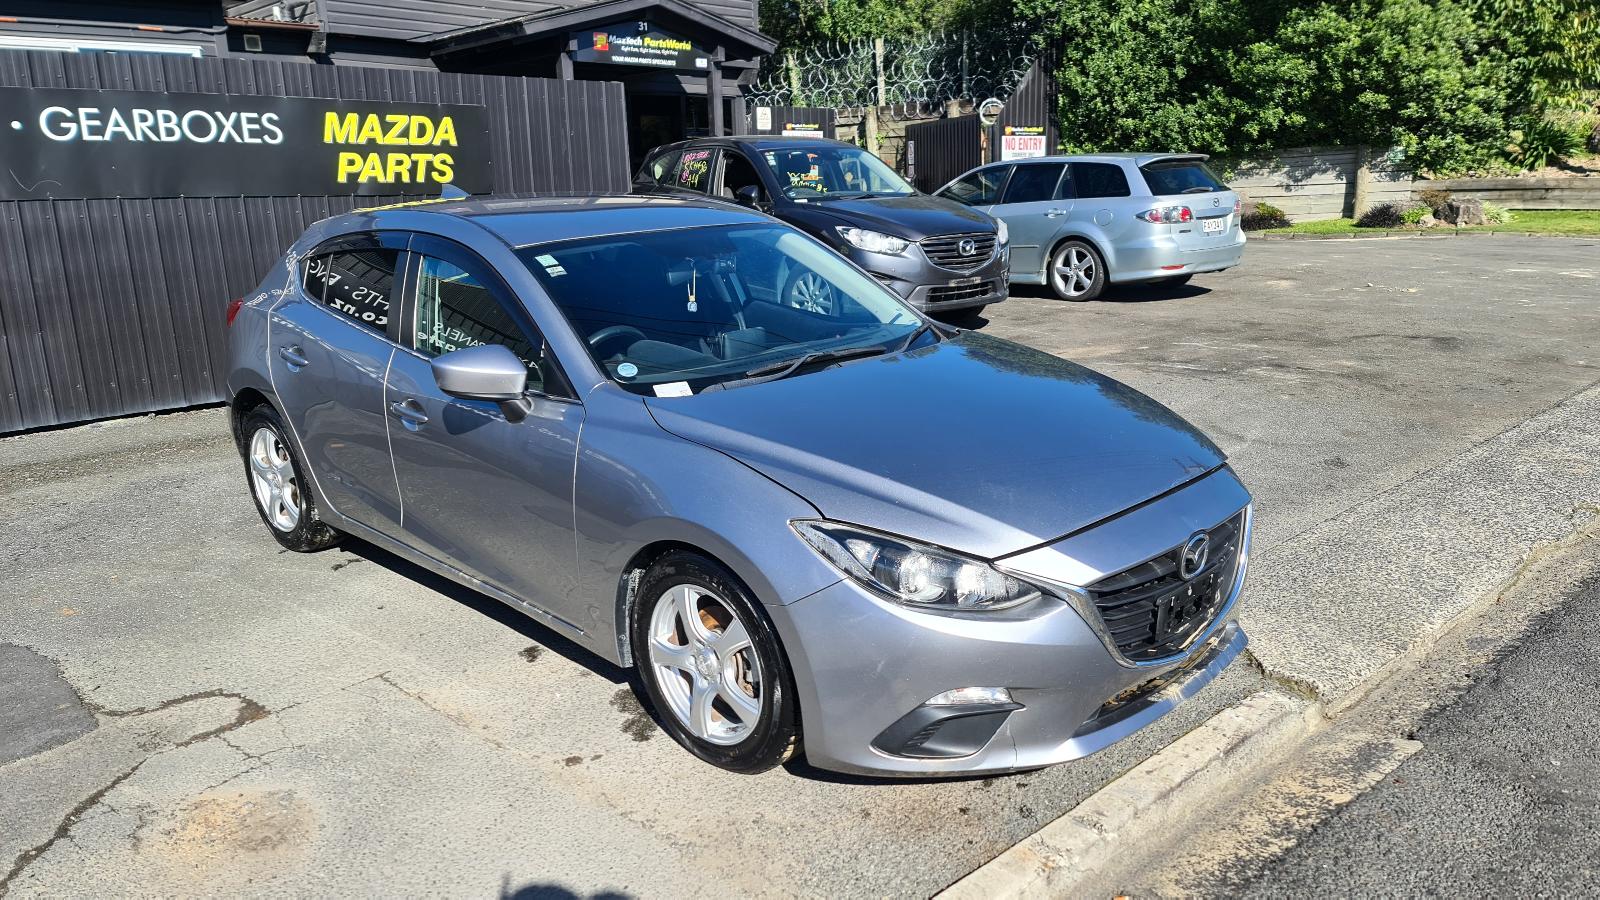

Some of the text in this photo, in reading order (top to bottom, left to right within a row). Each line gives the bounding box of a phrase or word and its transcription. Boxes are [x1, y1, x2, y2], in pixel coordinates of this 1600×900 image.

[638, 22, 648, 31] 31
[609, 34, 691, 51] MazTech PartsWorld
[39, 106, 284, 145] GEARBOXES
[322, 111, 458, 147] MAZDA
[1005, 137, 1043, 151] NO ENTRY
[336, 152, 455, 184] PARTS
